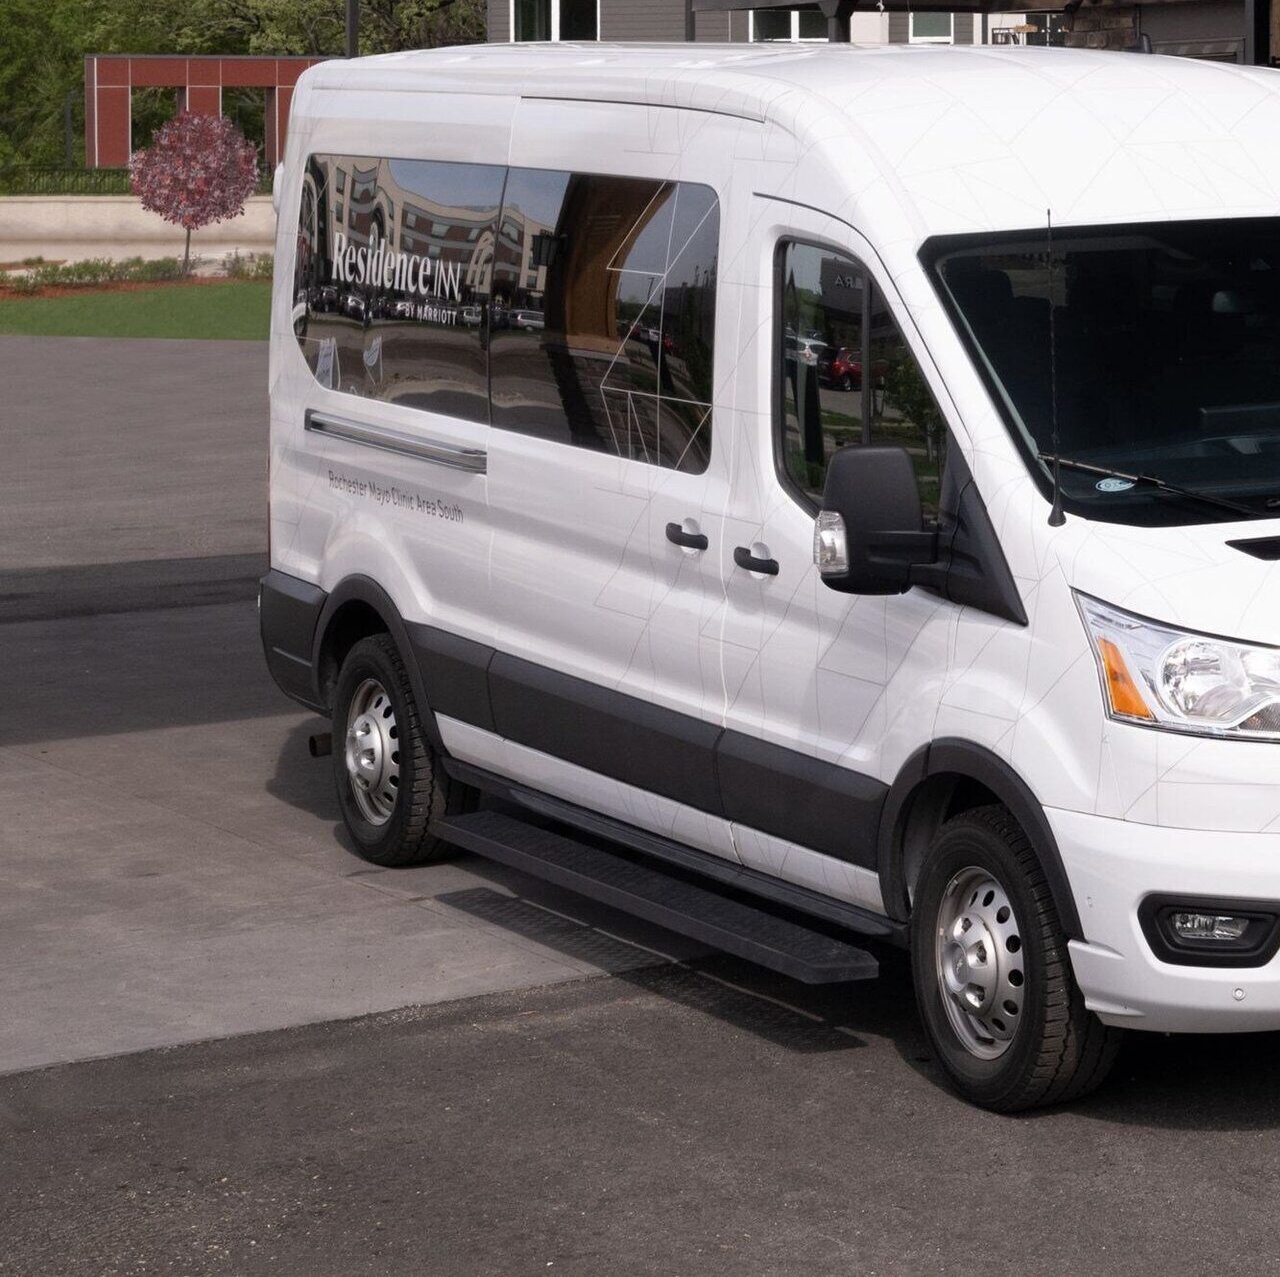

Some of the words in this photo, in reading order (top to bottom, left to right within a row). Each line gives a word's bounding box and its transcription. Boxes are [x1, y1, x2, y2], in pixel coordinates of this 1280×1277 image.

[332, 232, 431, 296] Residence
[433, 259, 461, 301] INN
[405, 302, 415, 317] BY
[417, 304, 458, 325] MARRIOTT
[328, 470, 368, 498] Rochester
[369, 481, 391, 506] Mayo
[391, 486, 414, 510] Clinic
[416, 494, 437, 516] Area
[437, 499, 464, 523] South
